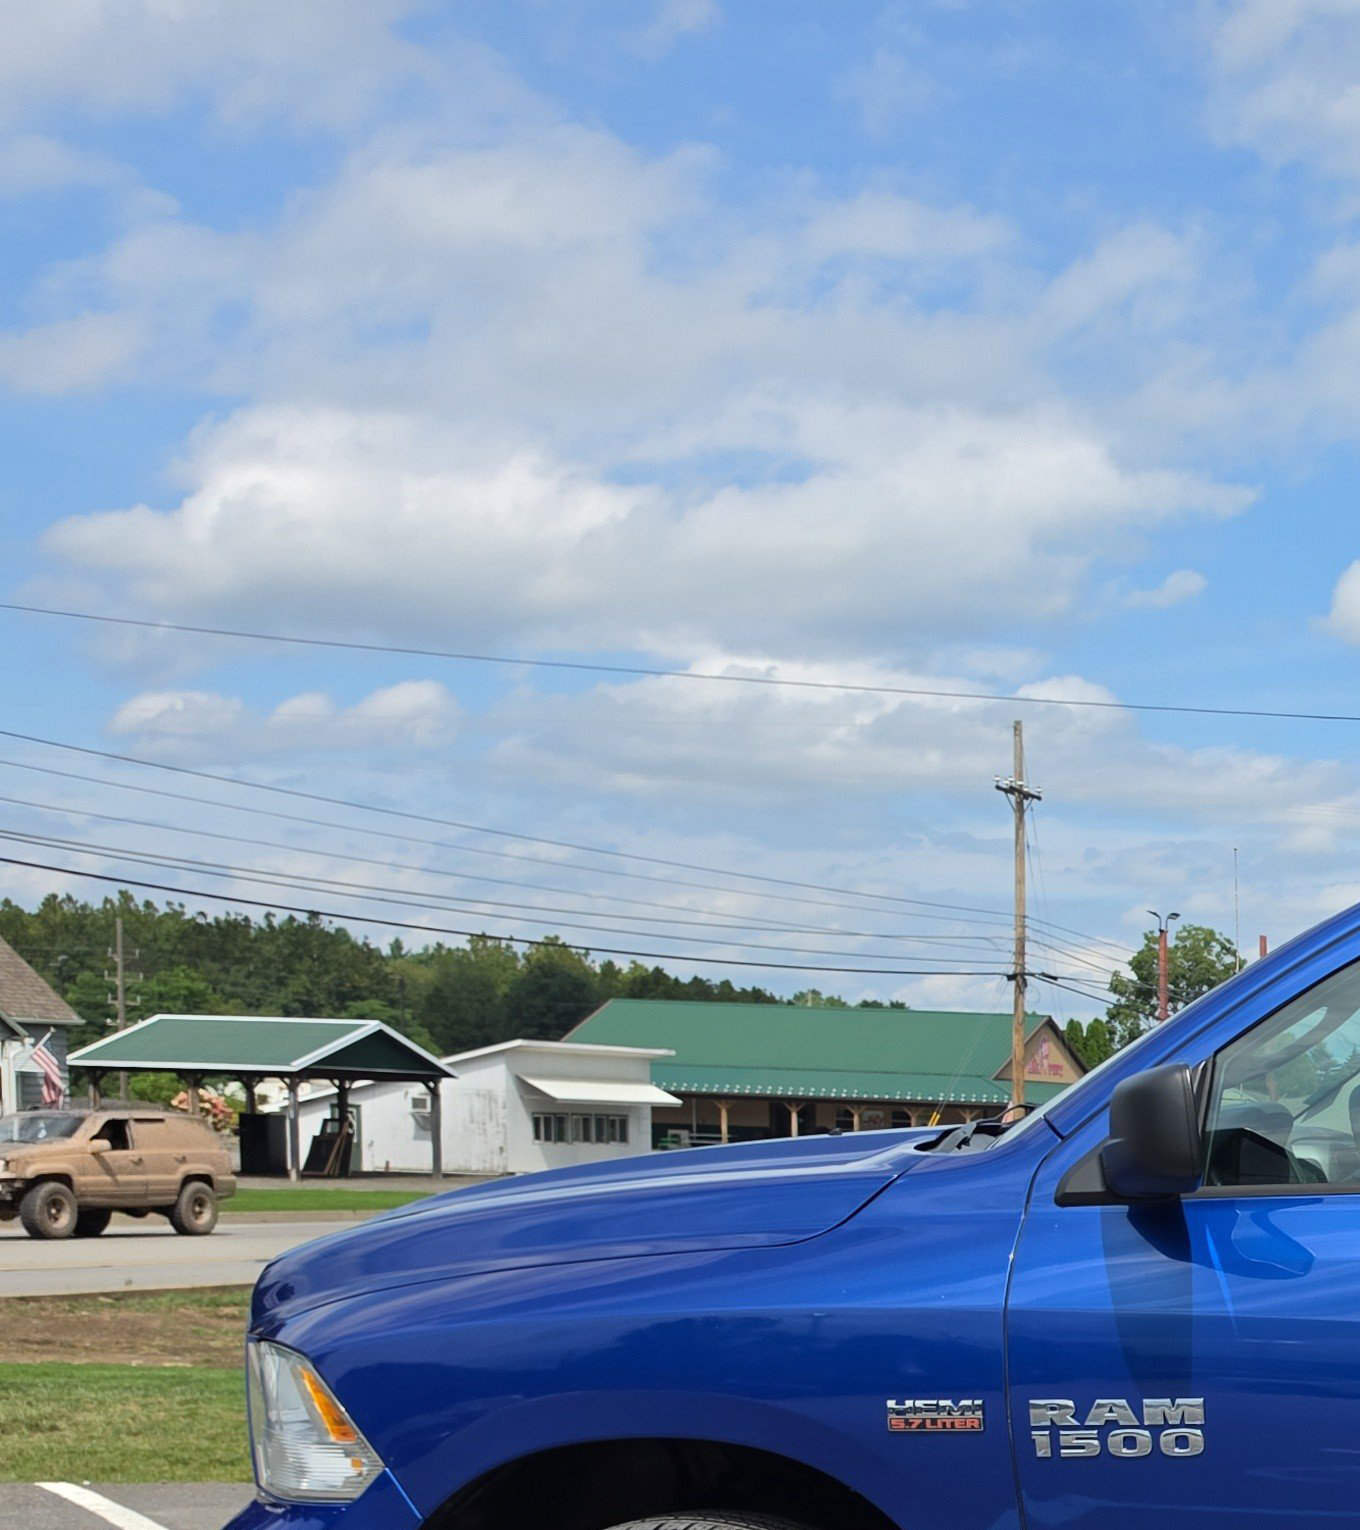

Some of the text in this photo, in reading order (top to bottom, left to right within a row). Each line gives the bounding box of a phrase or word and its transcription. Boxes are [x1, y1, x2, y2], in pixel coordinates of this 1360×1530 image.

[887, 1399, 984, 1417] HEMI
[1028, 1397, 1205, 1427] RAM
[890, 1418, 980, 1430] 5.7 LITER
[1030, 1428, 1205, 1458] 1500
